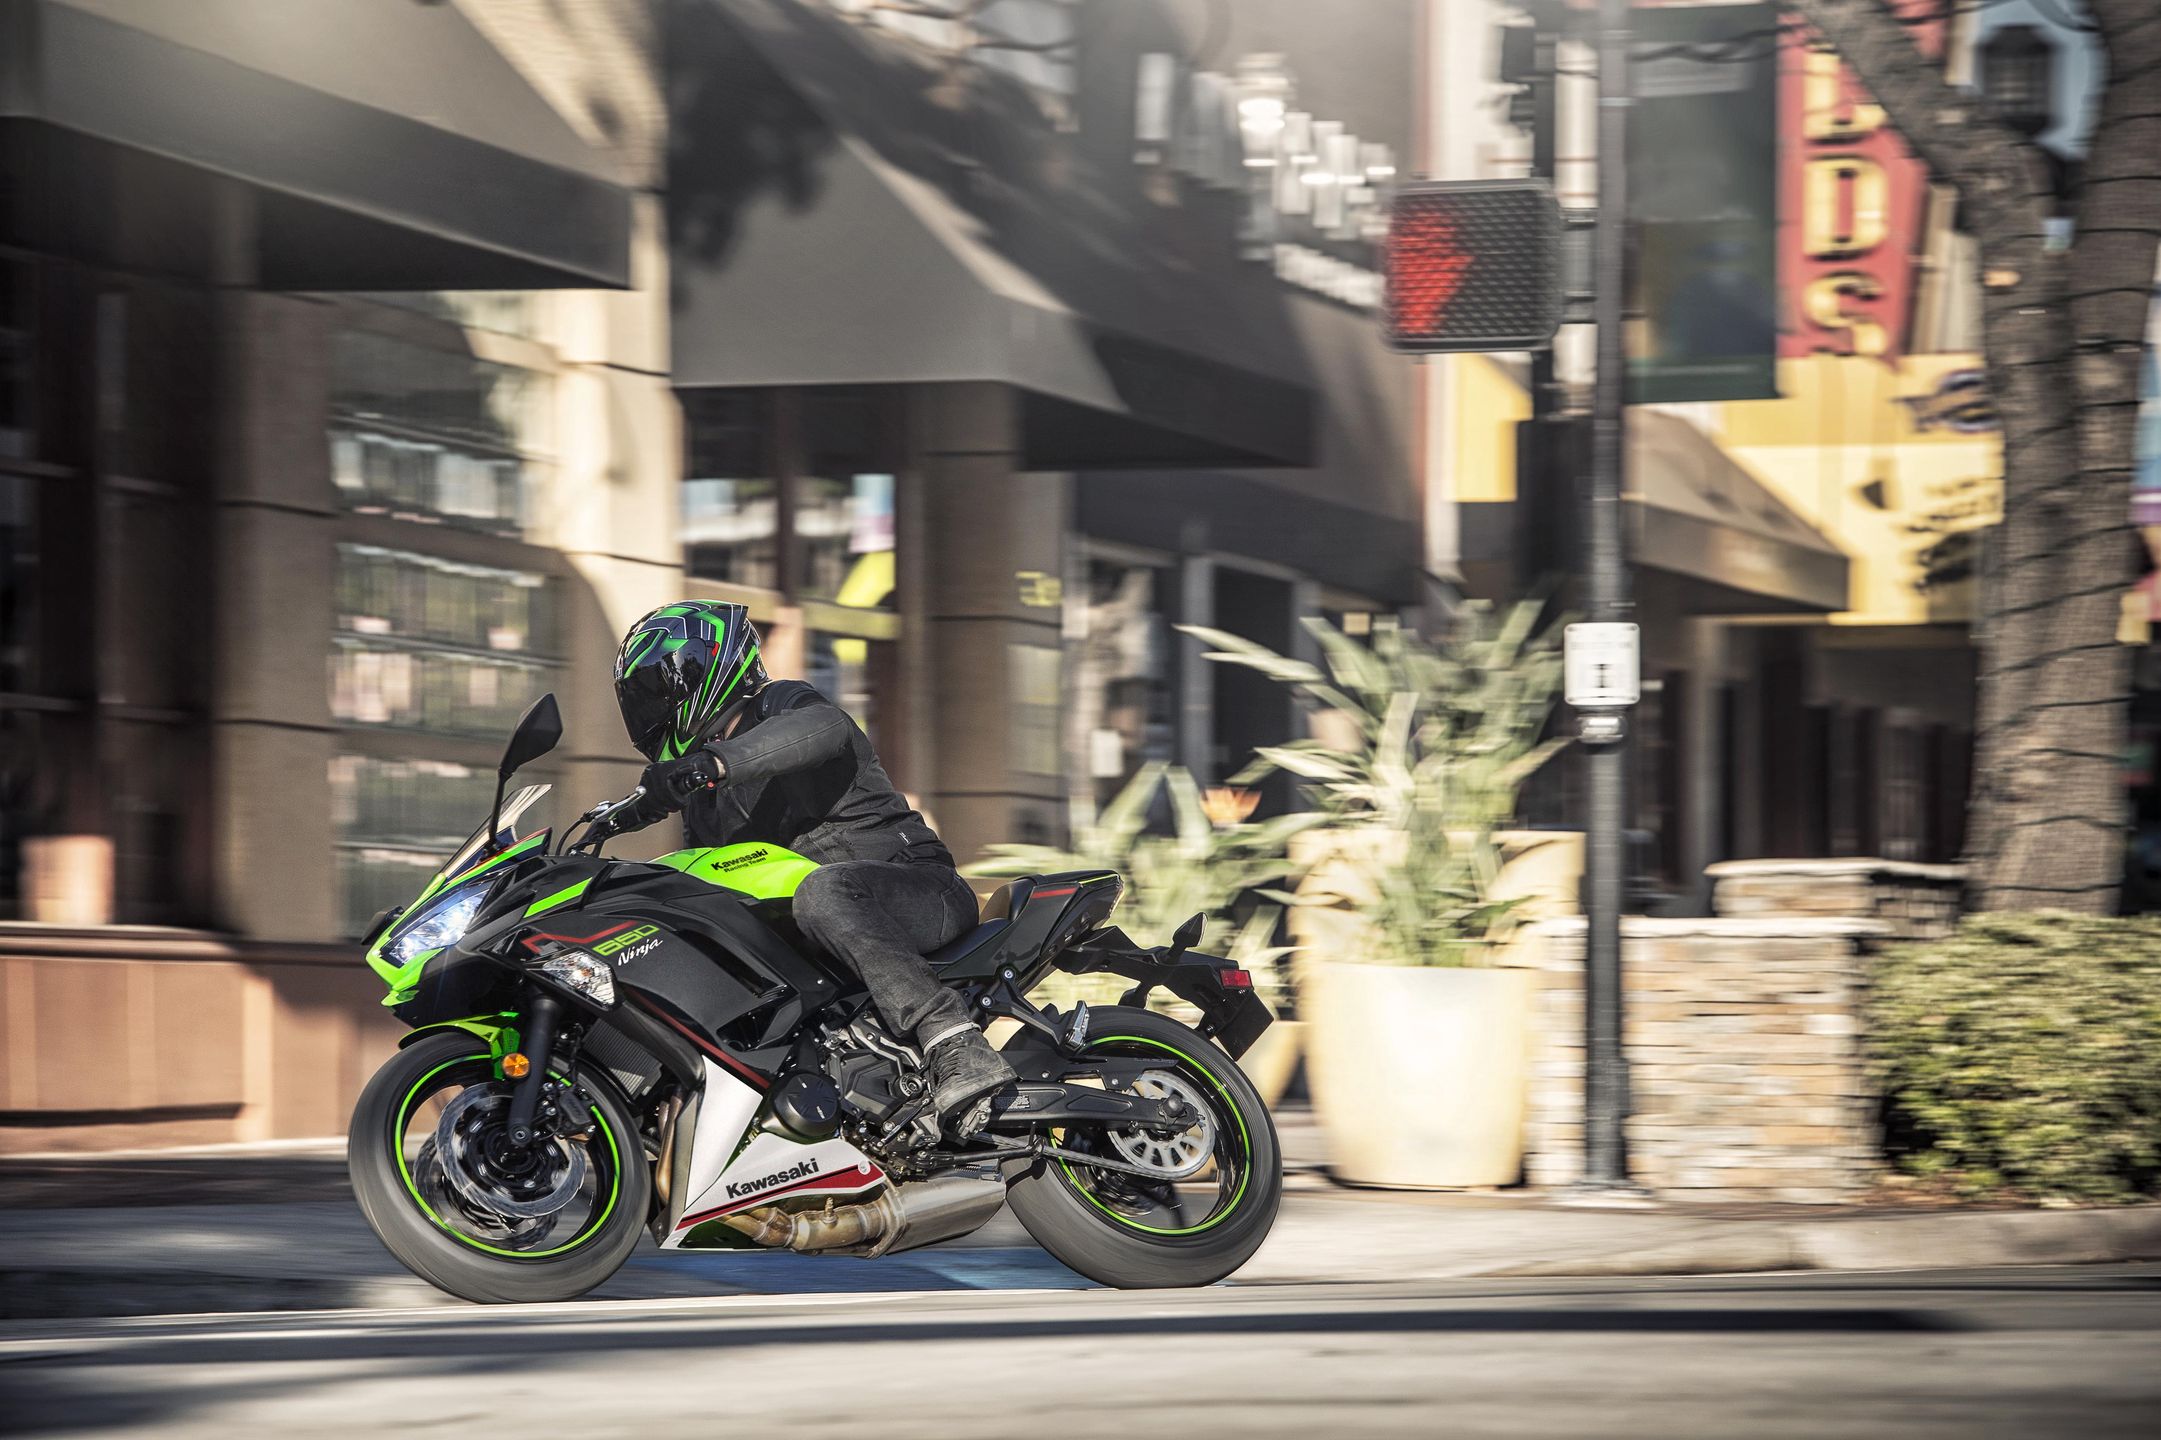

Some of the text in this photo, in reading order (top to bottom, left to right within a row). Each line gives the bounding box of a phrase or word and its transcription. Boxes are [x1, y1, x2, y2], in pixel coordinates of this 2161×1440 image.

[711, 848, 768, 871] Kawasaki
[724, 857, 767, 873] Racing Team
[592, 924, 660, 956] 650
[617, 938, 663, 966] Ninja
[725, 1157, 820, 1199] Kawasaki
